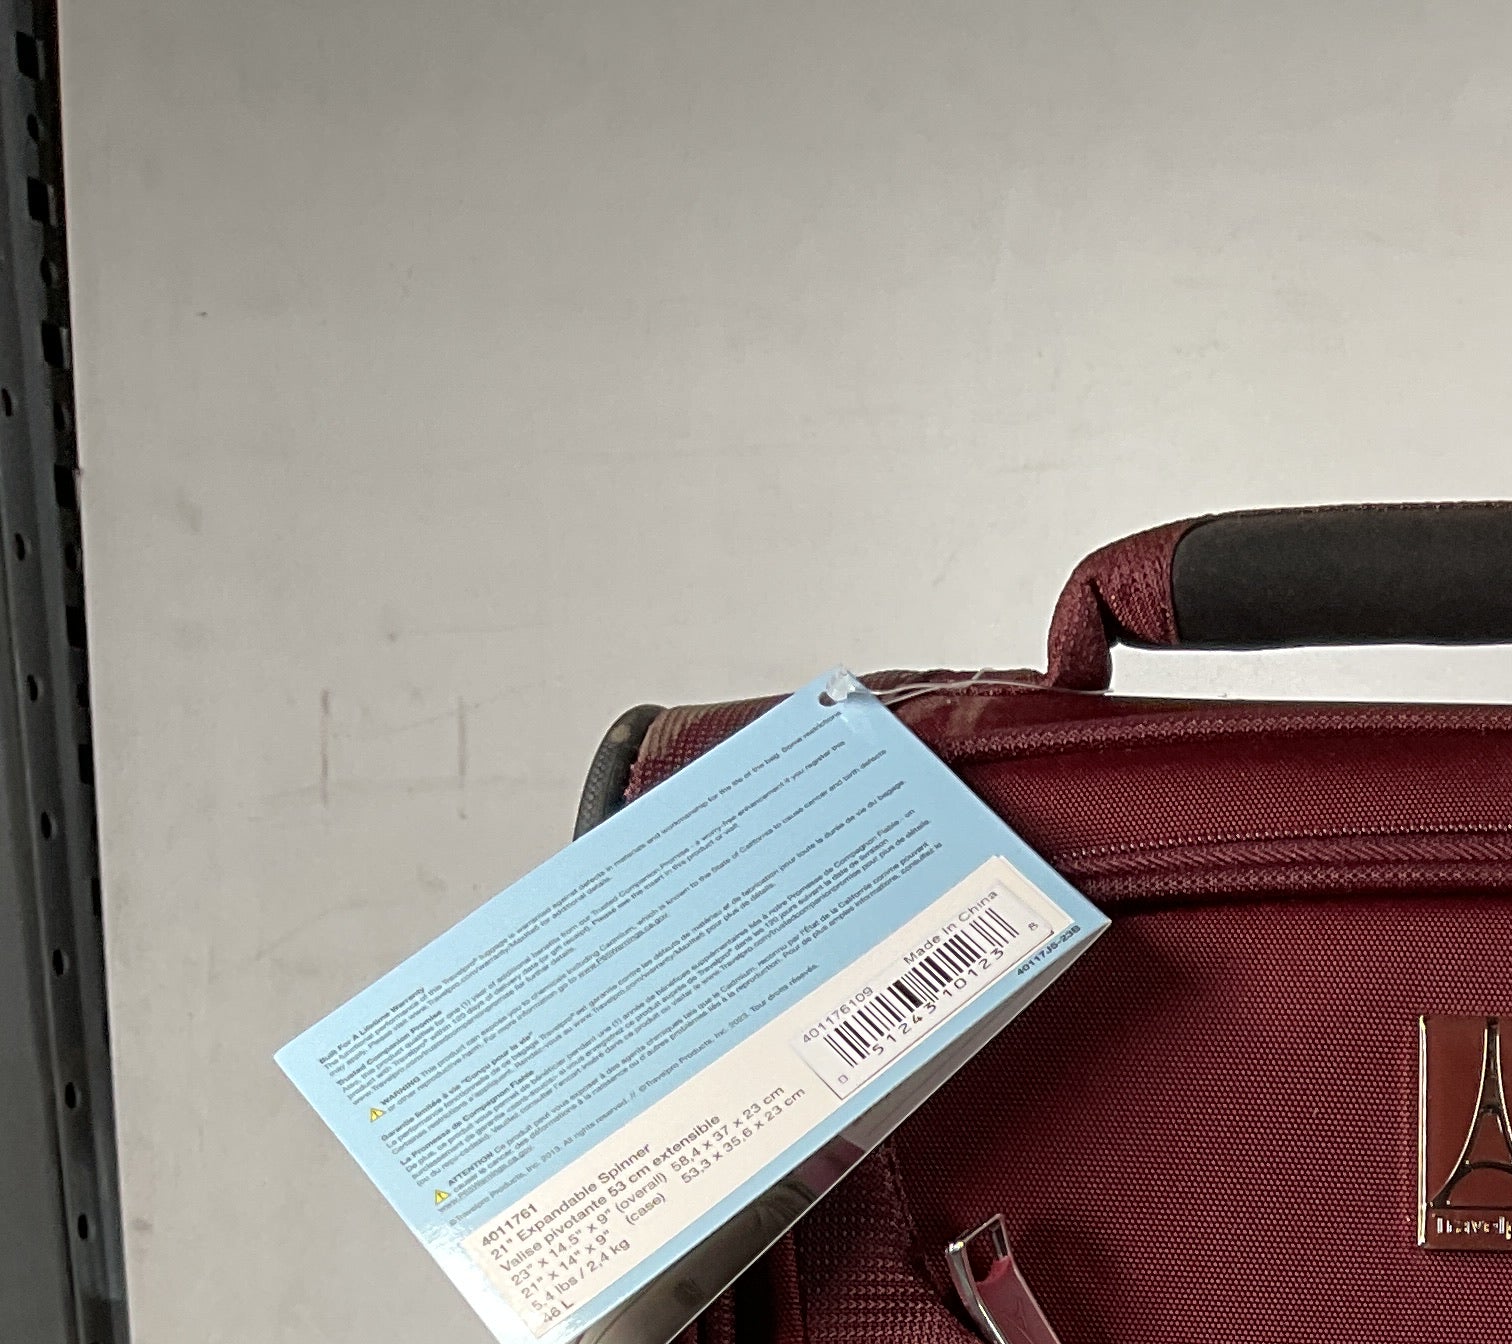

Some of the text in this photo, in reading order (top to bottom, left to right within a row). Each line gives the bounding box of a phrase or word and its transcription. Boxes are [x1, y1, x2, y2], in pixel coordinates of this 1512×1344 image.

[902, 933, 942, 964] Made
[955, 889, 999, 923] China
[799, 985, 875, 1044] 401176109
[869, 1001, 940, 1056] 51243
[940, 946, 1007, 999] 10123
[500, 1111, 721, 1275] Valise pivotante 53 cm extensible
[516, 1178, 599, 1245] Expandable
[595, 1140, 654, 1187] Spinner
[537, 1256, 549, 1268] x
[585, 1221, 598, 1233] x
[613, 1170, 669, 1215] (overall)
[701, 1139, 713, 1150] x
[711, 1124, 732, 1142] 37
[731, 1117, 744, 1128] x
[741, 1101, 763, 1120] 23
[761, 1086, 785, 1105] cm
[547, 1270, 560, 1282] x
[584, 1243, 597, 1255] x
[623, 1190, 667, 1226] (case)
[710, 1149, 723, 1161] x
[753, 1119, 765, 1130] x
[762, 1103, 784, 1122] 23
[782, 1087, 806, 1107] cm
[479, 1202, 539, 1250] 4011761
[553, 1273, 579, 1296] lbs
[575, 1267, 587, 1279] /
[609, 1237, 632, 1258] kg
[559, 1296, 575, 1311] L
